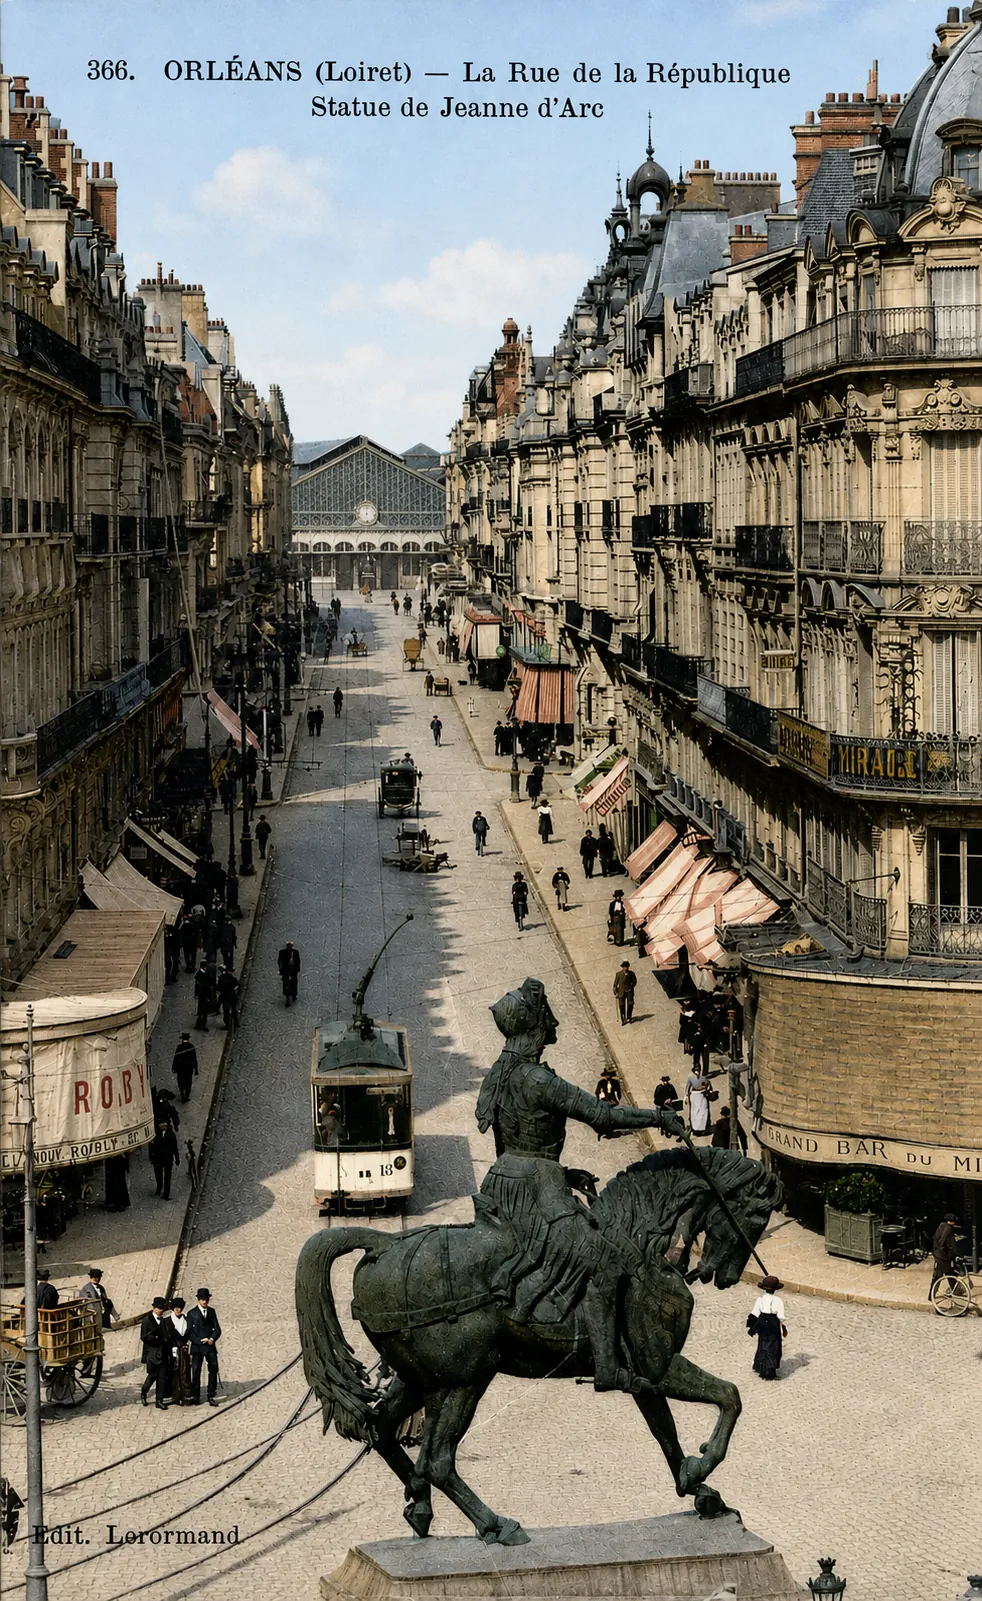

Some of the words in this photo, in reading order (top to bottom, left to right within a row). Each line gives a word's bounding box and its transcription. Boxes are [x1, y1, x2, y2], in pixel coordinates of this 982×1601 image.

[768, 1126, 818, 1153] GRAND
[837, 1140, 888, 1160] BAR
[906, 1152, 932, 1166] DU
[953, 1156, 981, 1172] MI
